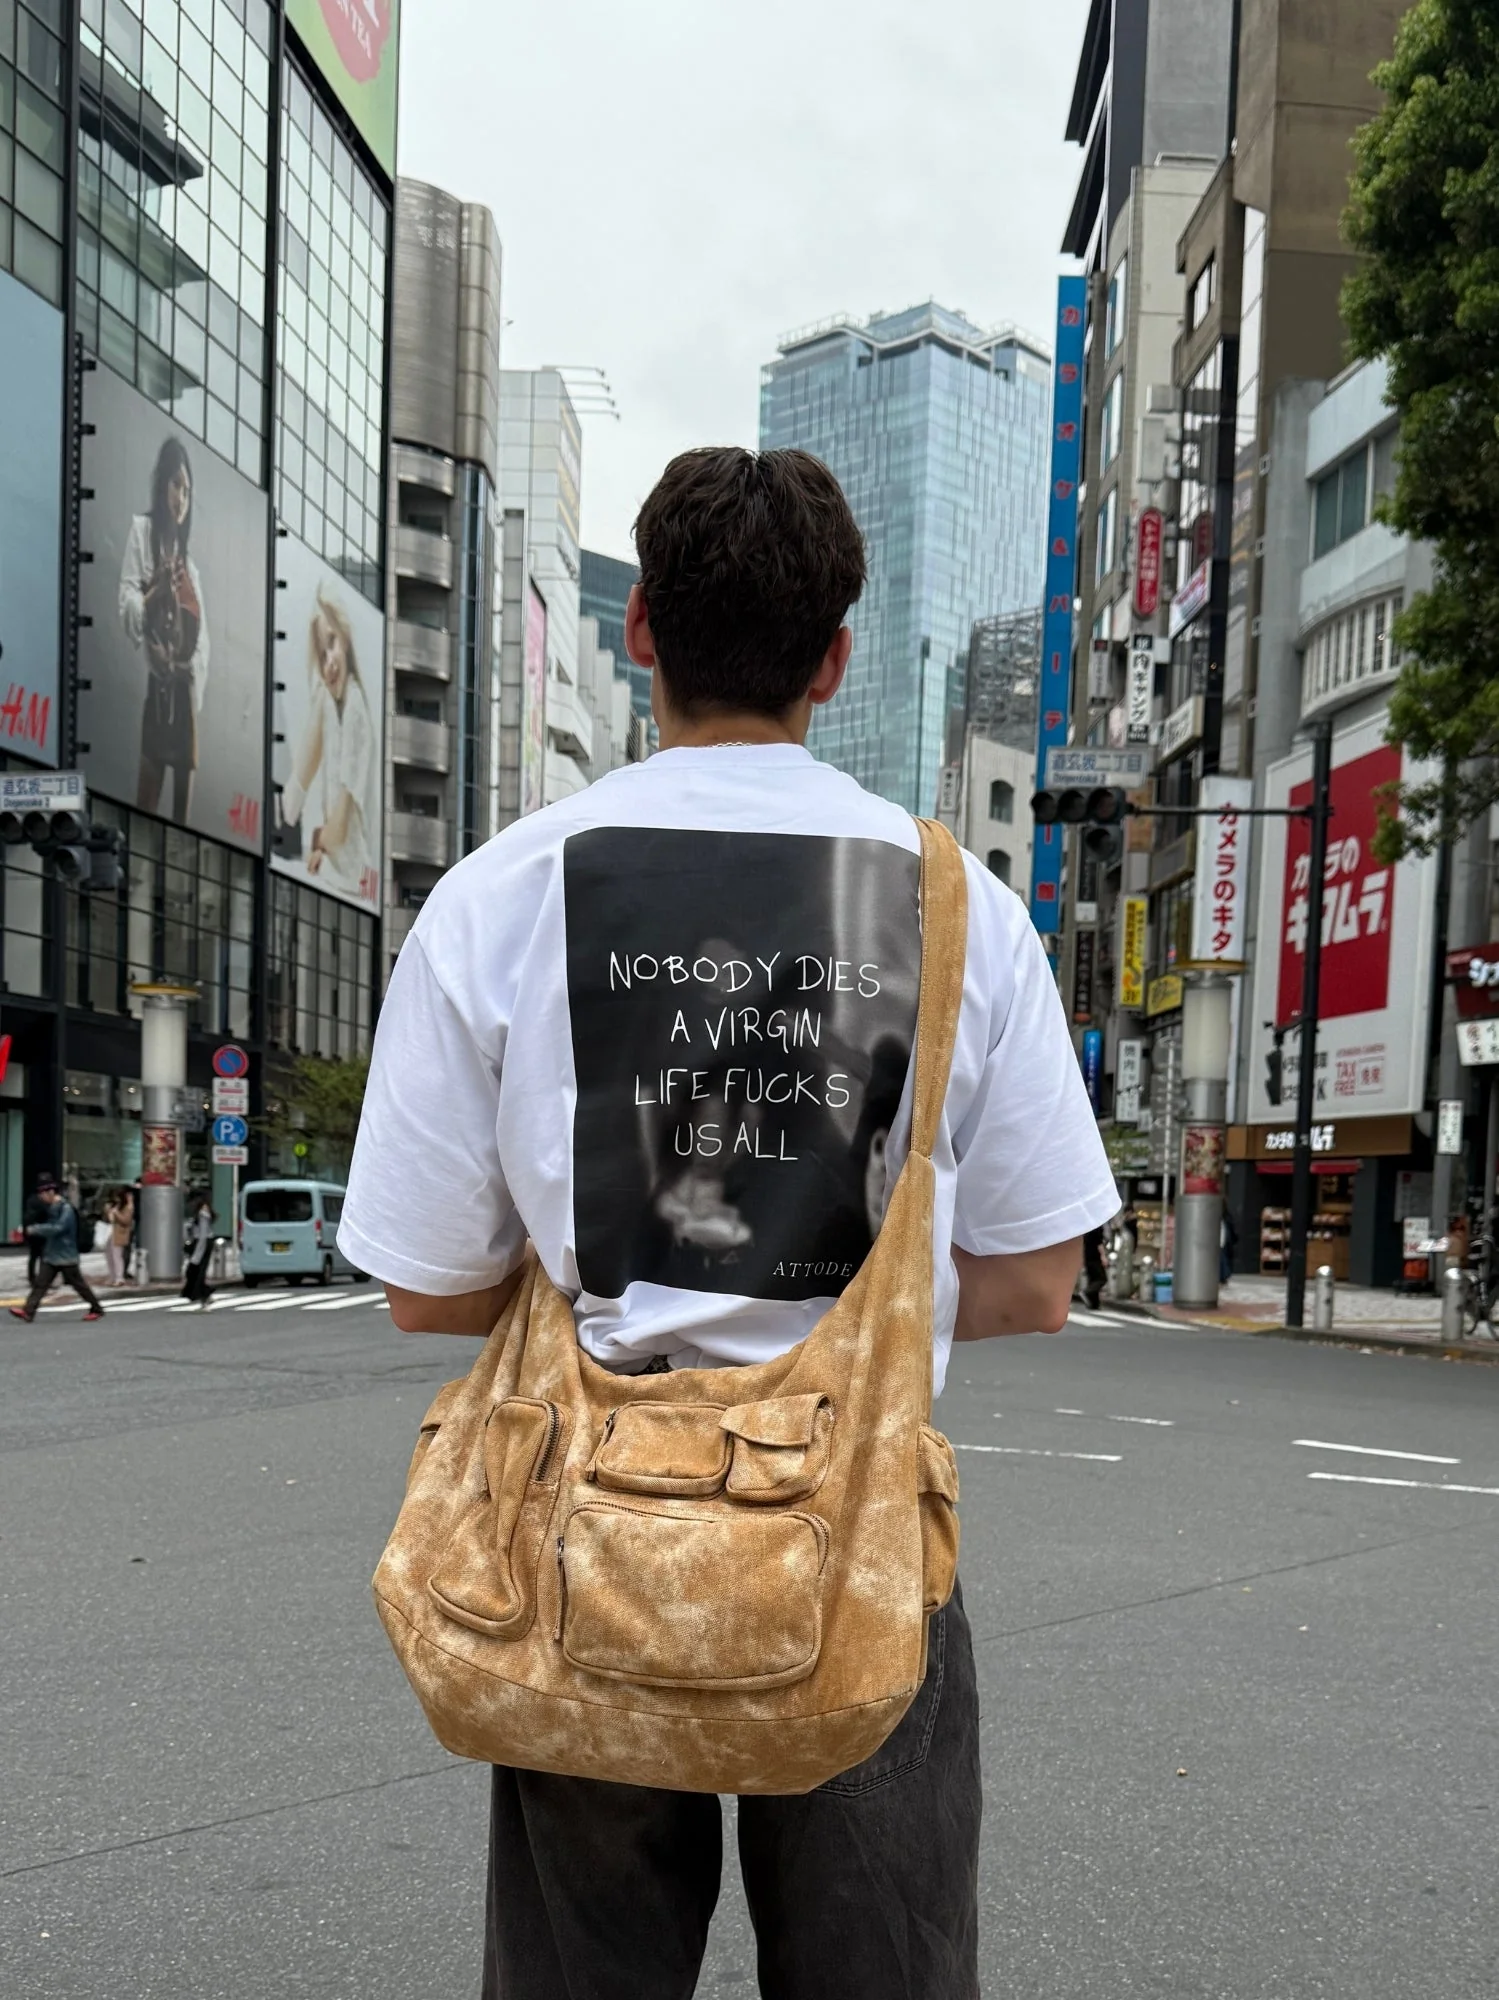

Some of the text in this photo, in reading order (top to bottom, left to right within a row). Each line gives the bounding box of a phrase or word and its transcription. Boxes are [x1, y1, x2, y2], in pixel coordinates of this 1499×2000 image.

[1212, 801, 1238, 961] カメラのキタ
[1290, 835, 1361, 891] カラの
[609, 951, 881, 998] NOBODY DIES
[670, 1006, 821, 1054] A VIRGIN
[635, 1068, 850, 1108] LIFE FUCKS
[220, 1120, 234, 1143] P
[674, 1121, 799, 1161] US ALL
[772, 1261, 853, 1278] ATTODE
